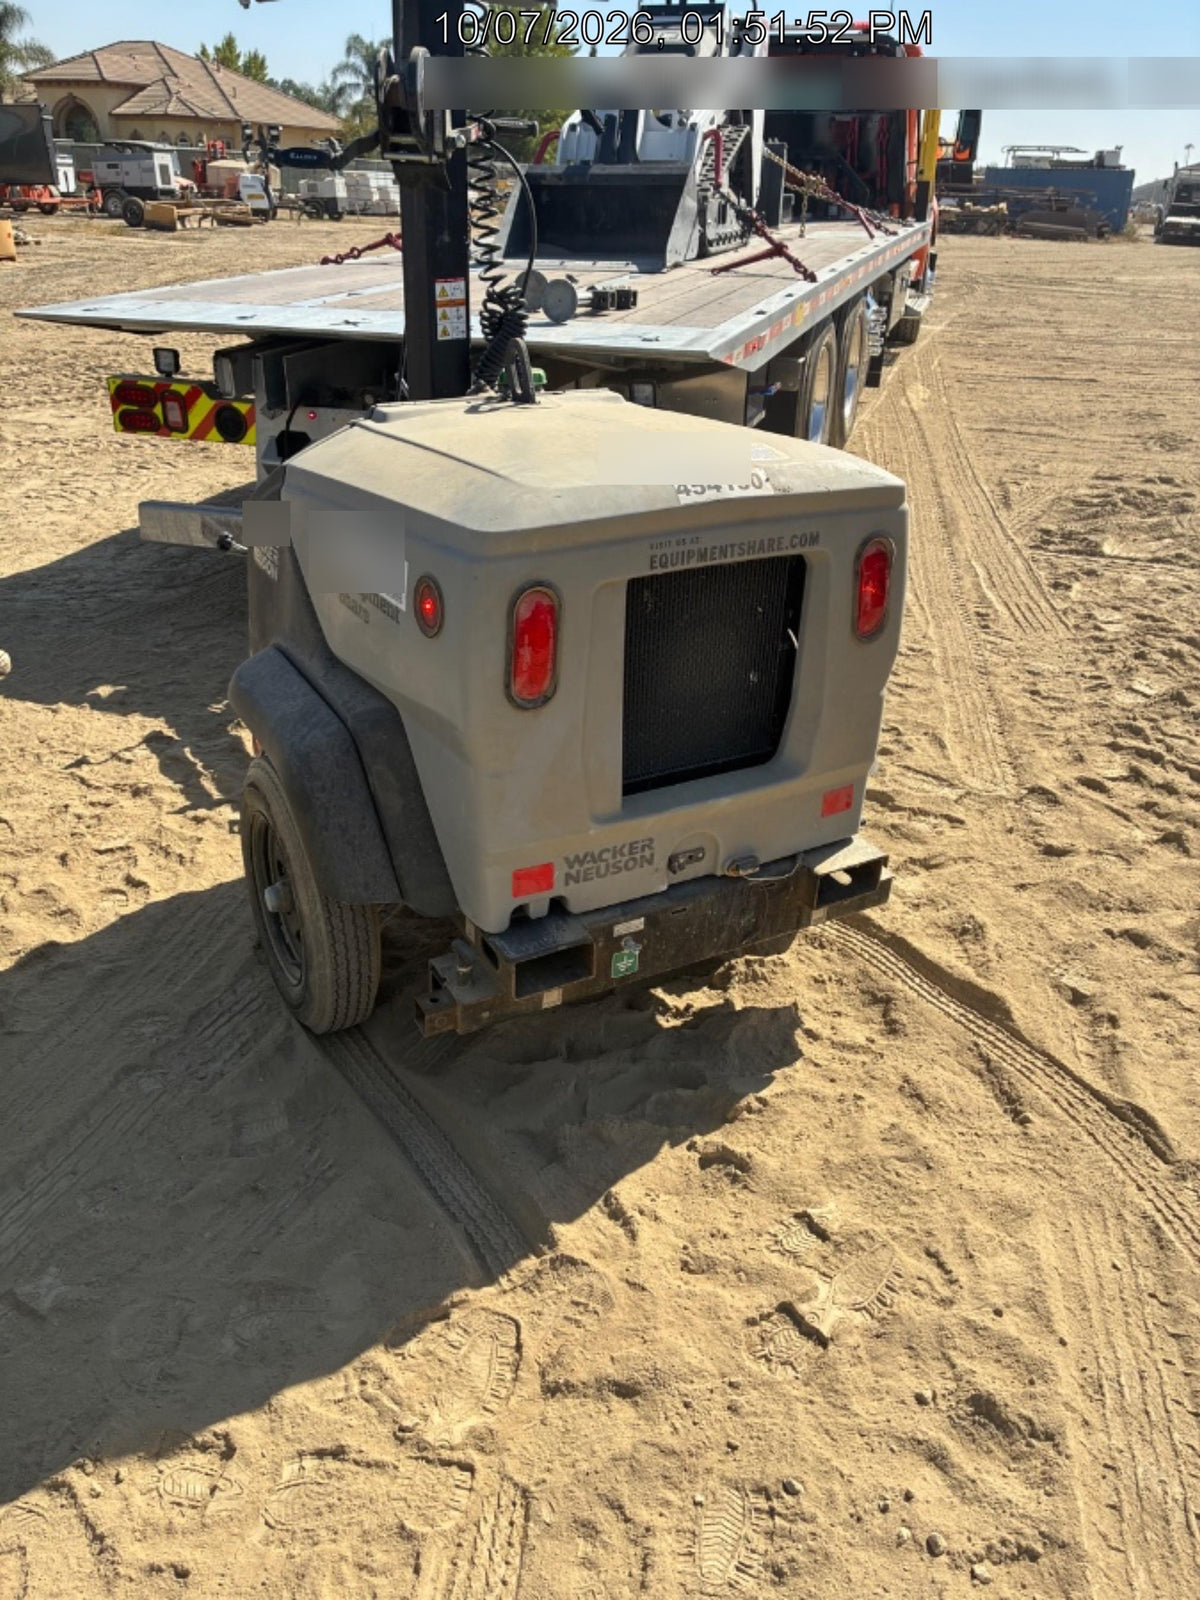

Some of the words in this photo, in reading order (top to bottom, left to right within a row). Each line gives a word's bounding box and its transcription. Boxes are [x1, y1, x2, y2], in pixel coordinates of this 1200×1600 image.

[650, 530, 820, 571] EQUIPMENTSHARE.COM
[563, 837, 655, 870] WACKER
[564, 852, 655, 887] NEUSON
